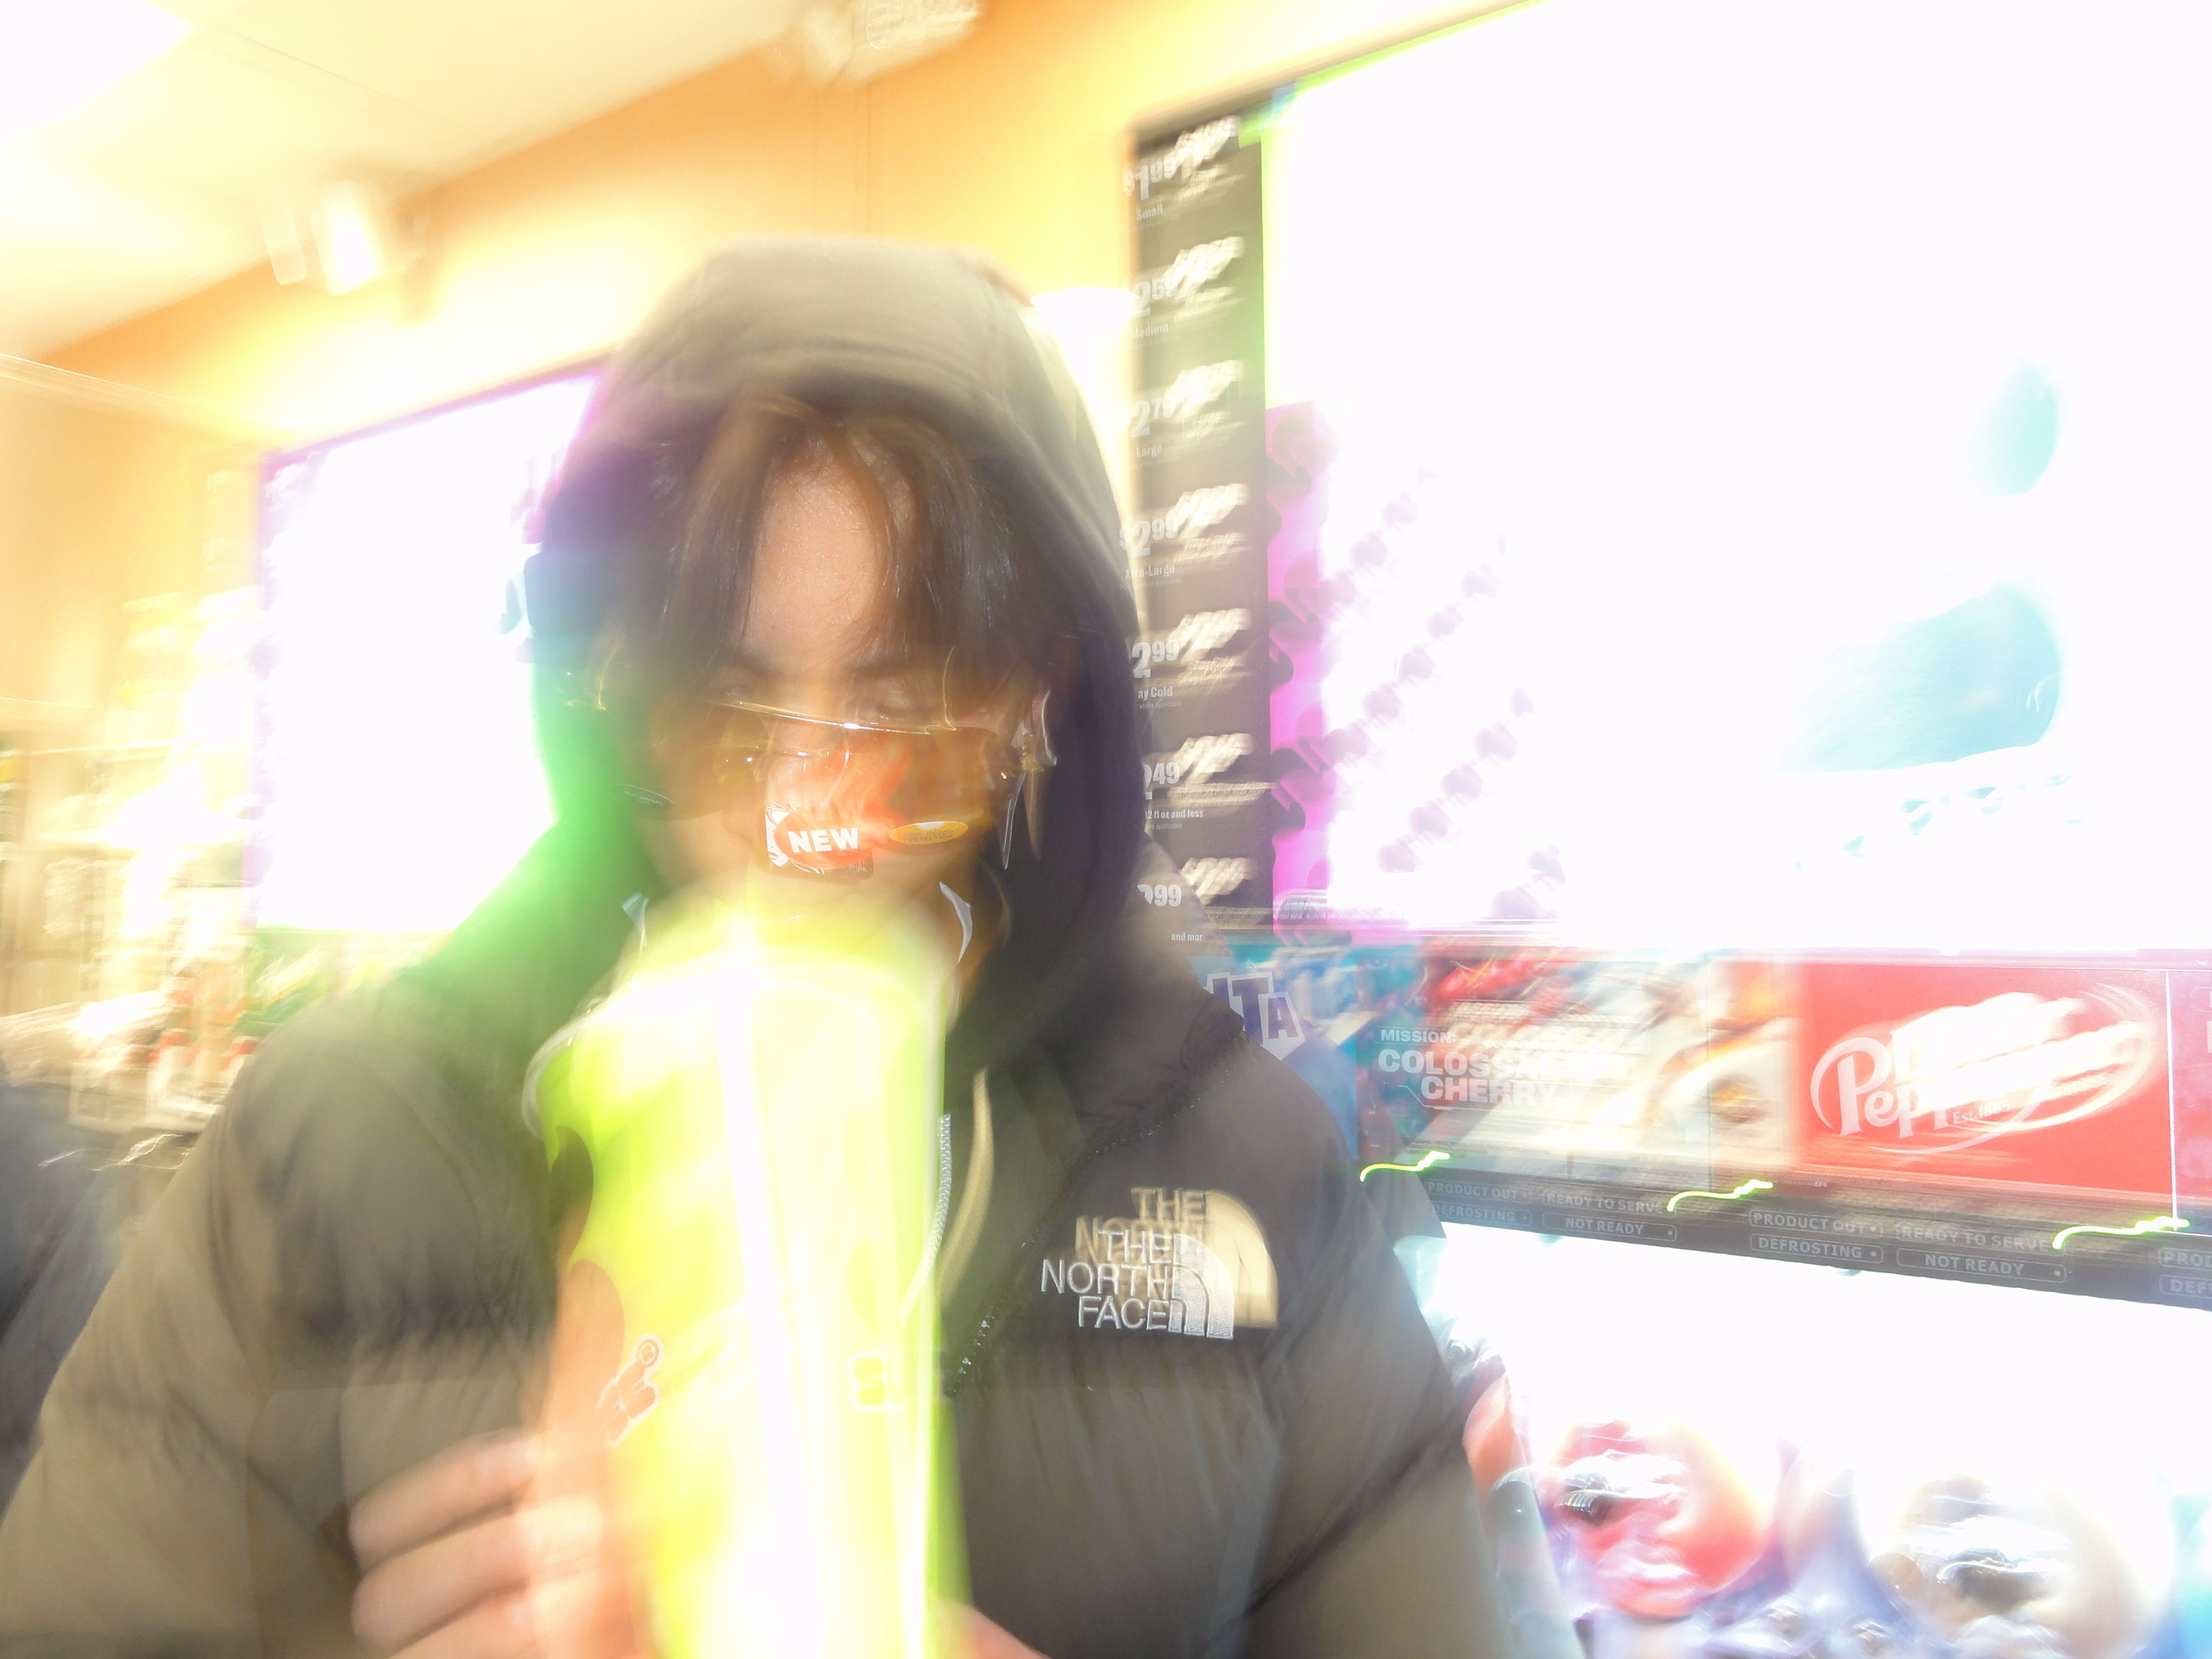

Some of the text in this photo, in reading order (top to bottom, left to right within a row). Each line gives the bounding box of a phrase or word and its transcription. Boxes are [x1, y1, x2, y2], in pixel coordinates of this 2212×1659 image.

[1150, 686, 1173, 698] Cold
[1171, 809, 1185, 819] and
[788, 827, 859, 853] NEW
[1170, 933, 1185, 941] and
[1421, 1076, 1558, 1106] CHERRY
[1428, 1181, 1518, 1200] PRODUCT OUT
[1432, 1205, 1517, 1222] DEFROSTING
[1753, 1212, 1868, 1236] PRODUCT OUT
[1566, 1218, 1644, 1236] NOT READY
[1098, 1230, 1171, 1264] THE
[1758, 1236, 1863, 1259] DEFROSTING
[1902, 1225, 2052, 1253] READY TO SERVE
[1925, 1254, 2025, 1278] NOT READY
[1041, 1259, 1172, 1299] NORTH
[2170, 1279, 2212, 1296] DEF
[1078, 1295, 1170, 1331] FACE
